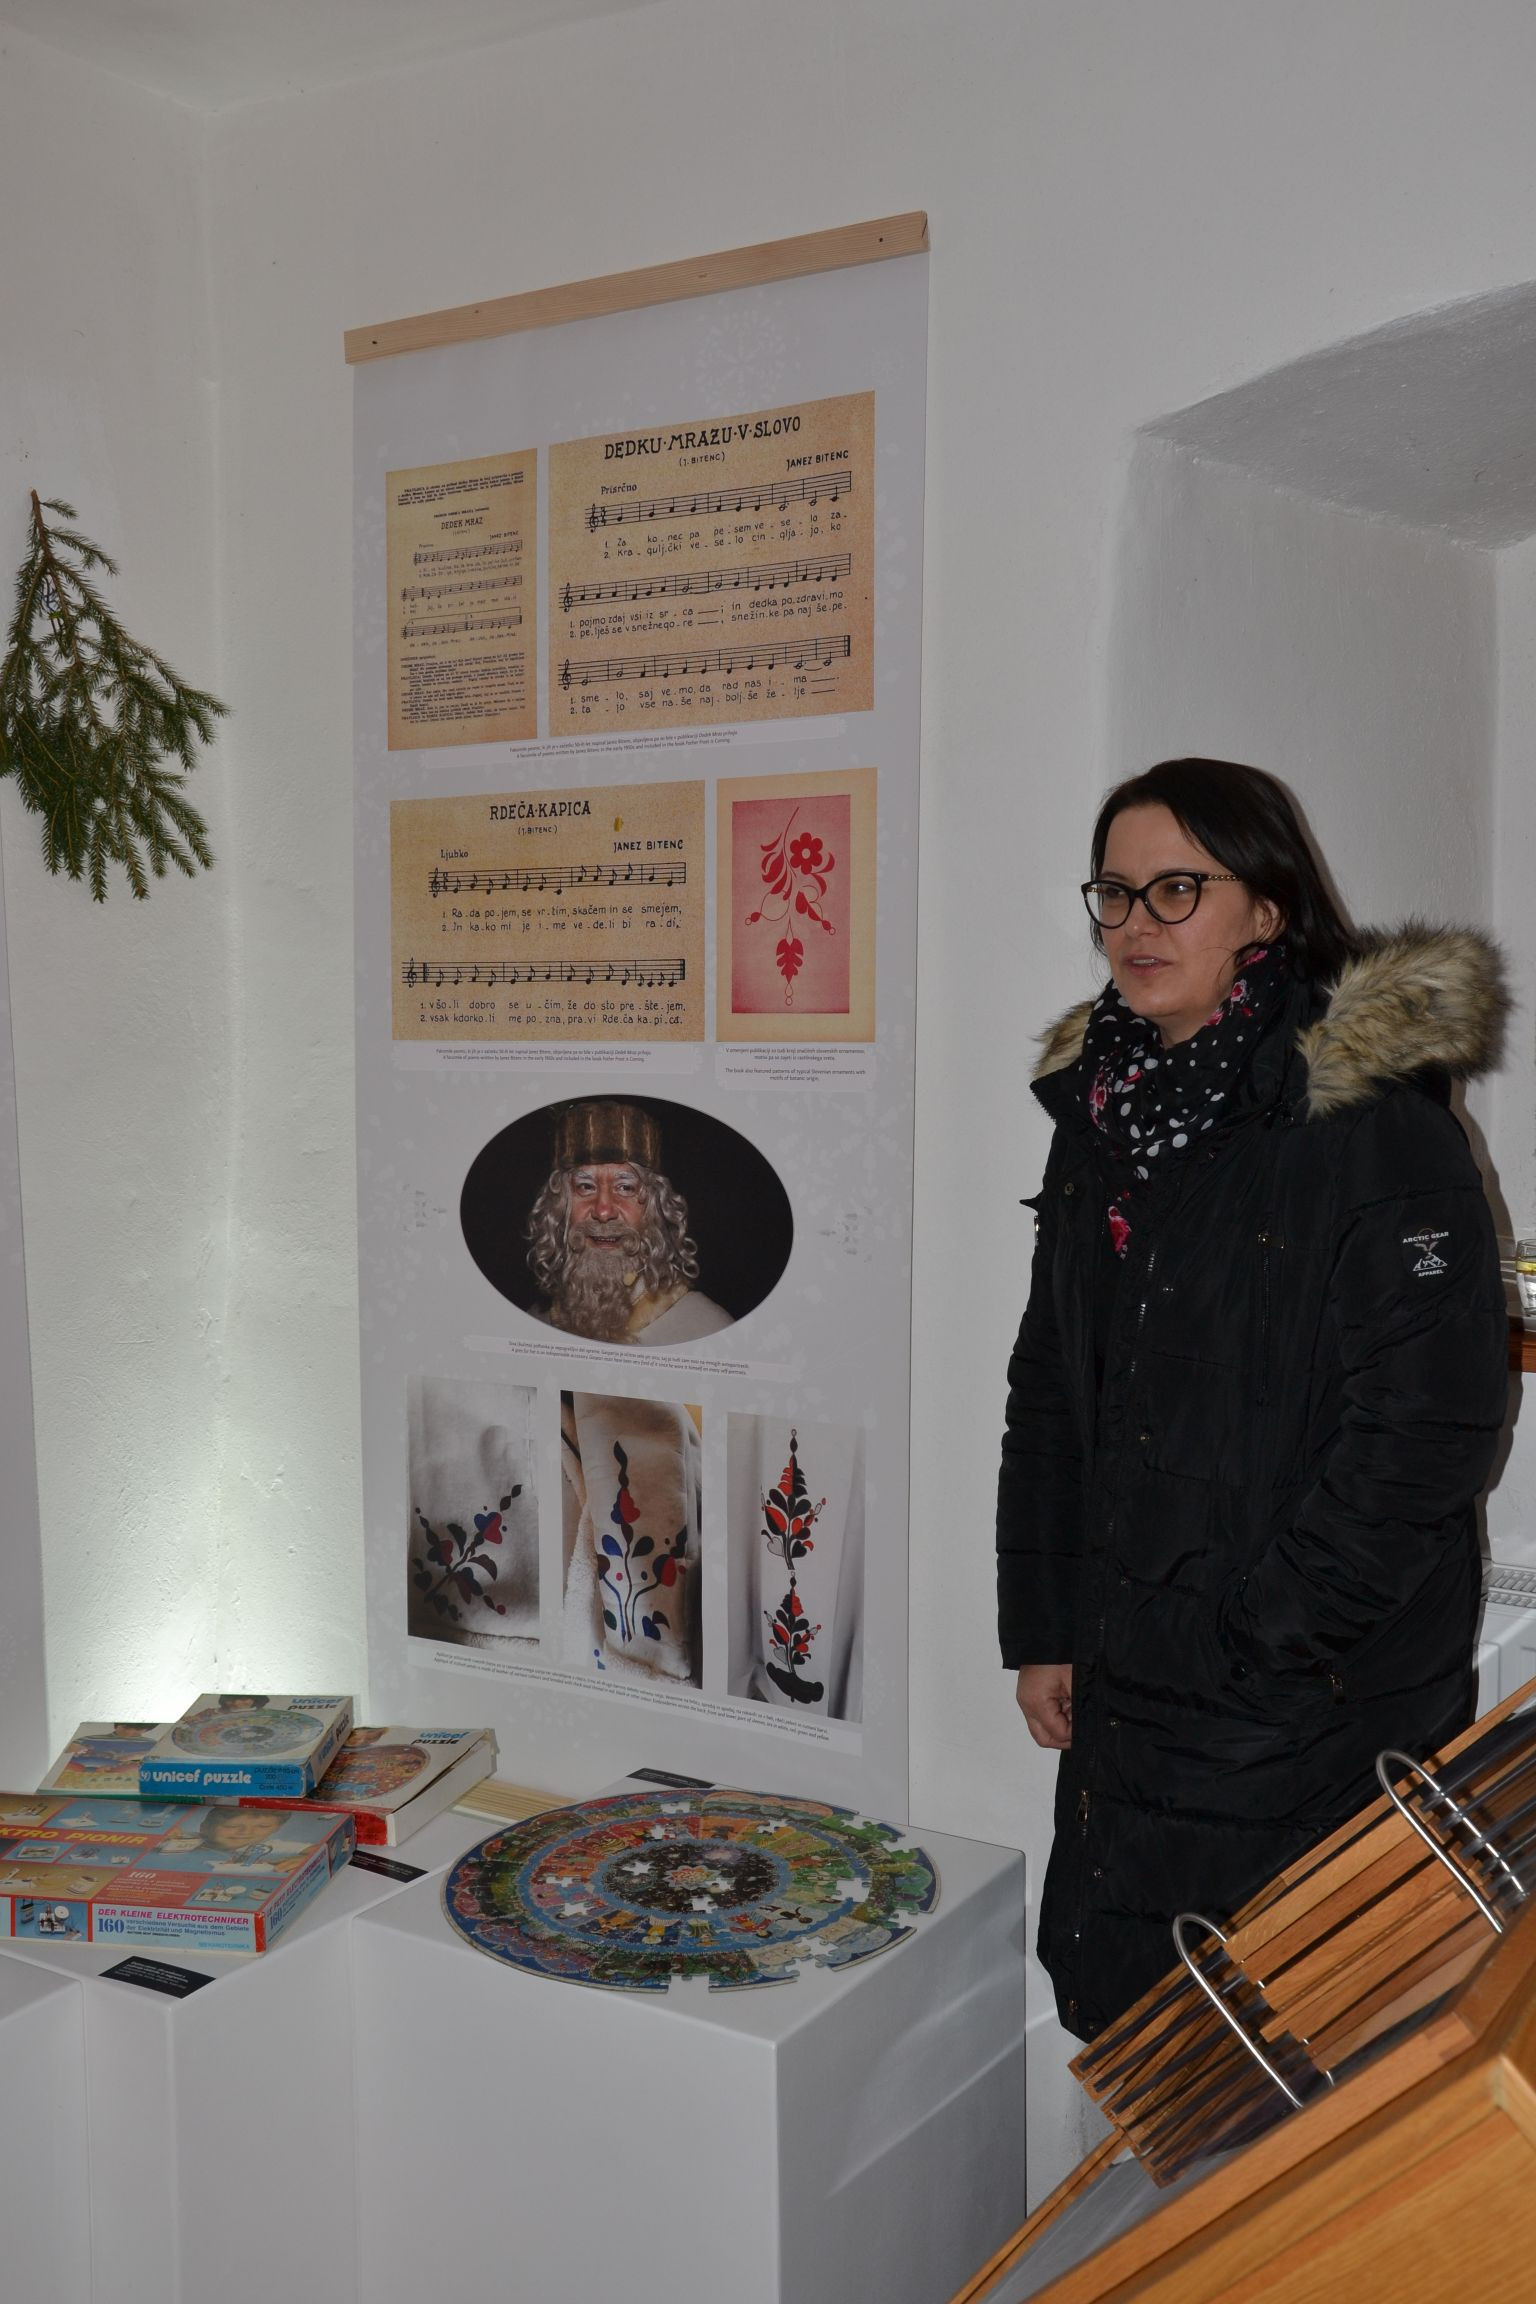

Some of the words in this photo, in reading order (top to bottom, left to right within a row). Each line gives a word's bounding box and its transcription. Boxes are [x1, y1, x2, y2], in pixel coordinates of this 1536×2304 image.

[605, 438, 661, 459] DEDKU
[753, 416, 801, 437] SLOVO
[786, 457, 812, 471] JANEZ
[816, 450, 849, 464] BITENC
[601, 484, 637, 495] Prisrčno
[690, 531, 700, 540] pa
[580, 617, 606, 628] pojmo
[608, 615, 626, 624] zdaj
[630, 612, 642, 620] vsi
[732, 602, 740, 610] in
[749, 598, 778, 609] dedka
[612, 626, 622, 634] se
[784, 608, 794, 617] pa
[798, 606, 812, 616] naj
[639, 690, 653, 700] saj
[700, 684, 710, 692] da
[722, 680, 738, 690] rad
[745, 680, 761, 688] nas
[640, 700, 655, 708] vse
[490, 801, 534, 820] RDEČA
[538, 801, 591, 818] KAPICA
[613, 841, 641, 853] JANEZ
[647, 840, 684, 851] BITENC
[440, 849, 468, 860] Ljubko
[522, 908, 531, 916] se
[573, 904, 606, 915] skačem
[609, 905, 619, 913] in
[623, 905, 632, 913] se
[453, 922, 462, 931] In
[500, 922, 511, 931] mi
[522, 922, 530, 932] je
[623, 918, 631, 928] bi
[469, 1000, 495, 1009] dobro
[509, 1001, 519, 1009] se
[568, 998, 577, 1009] že
[584, 1000, 595, 1009] do
[601, 1000, 615, 1009] sto
[430, 1014, 449, 1022] vsak
[509, 1015, 521, 1023] me
[1403, 1235, 1430, 1243] ARCTIC
[1418, 1269, 1444, 1277] APPAREL
[420, 1730, 469, 1738] unicef
[153, 1769, 200, 1782] unicef
[203, 1770, 251, 1785] puzzle
[66, 1833, 148, 1844] PIONIR
[121, 1910, 152, 1918] KLEINE
[157, 1913, 249, 1925] ELEKTROTECHNIKER
[98, 1919, 124, 1933] 160
